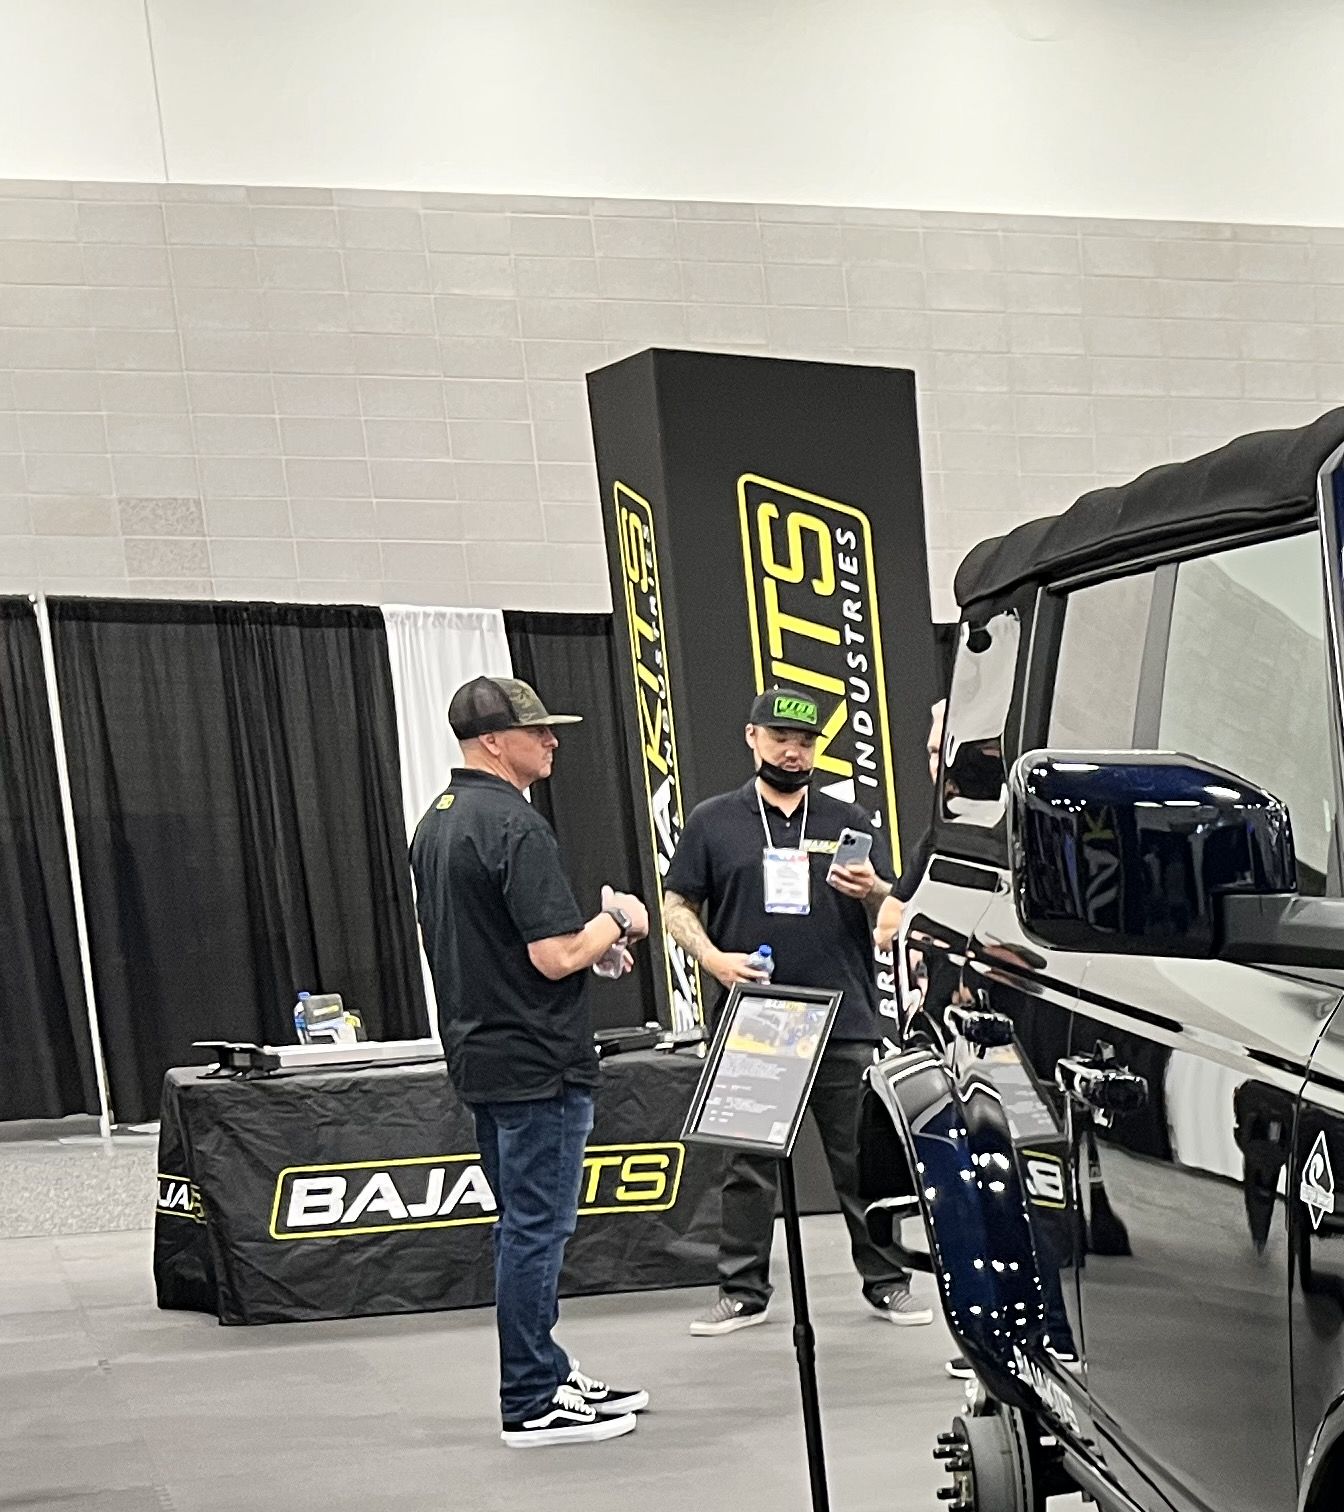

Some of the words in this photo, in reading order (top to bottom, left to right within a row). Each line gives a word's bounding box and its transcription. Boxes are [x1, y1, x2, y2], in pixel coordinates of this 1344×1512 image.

[621, 506, 668, 776] KITS
[835, 526, 879, 788] INDUSTRIES
[286, 1164, 498, 1228] BAJA
